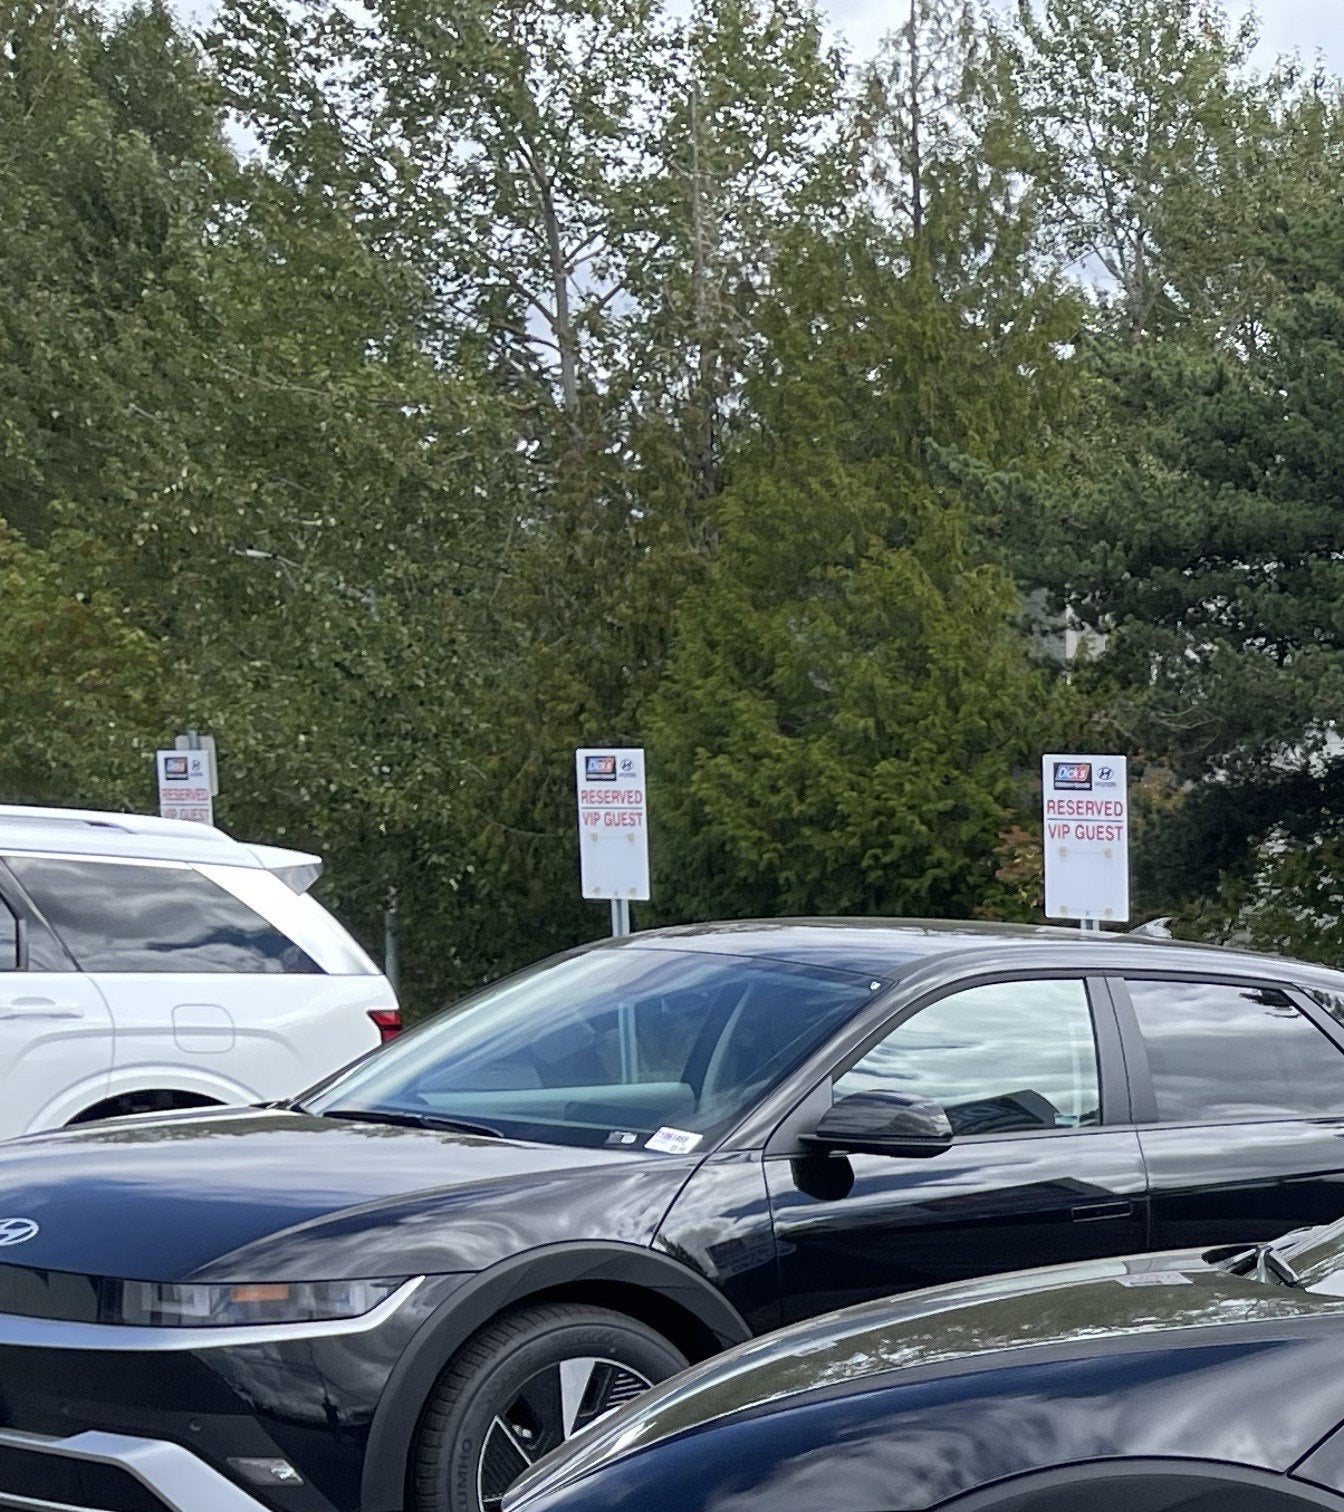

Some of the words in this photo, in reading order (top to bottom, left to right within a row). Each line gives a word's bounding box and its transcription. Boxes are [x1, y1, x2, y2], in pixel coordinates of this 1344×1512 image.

[580, 789, 643, 805] RESERVED
[1046, 799, 1124, 817] RESERVED
[582, 812, 601, 827] VIP
[604, 811, 643, 827] GUEST
[1048, 824, 1070, 839] VIP
[1075, 825, 1124, 841] GUEST
